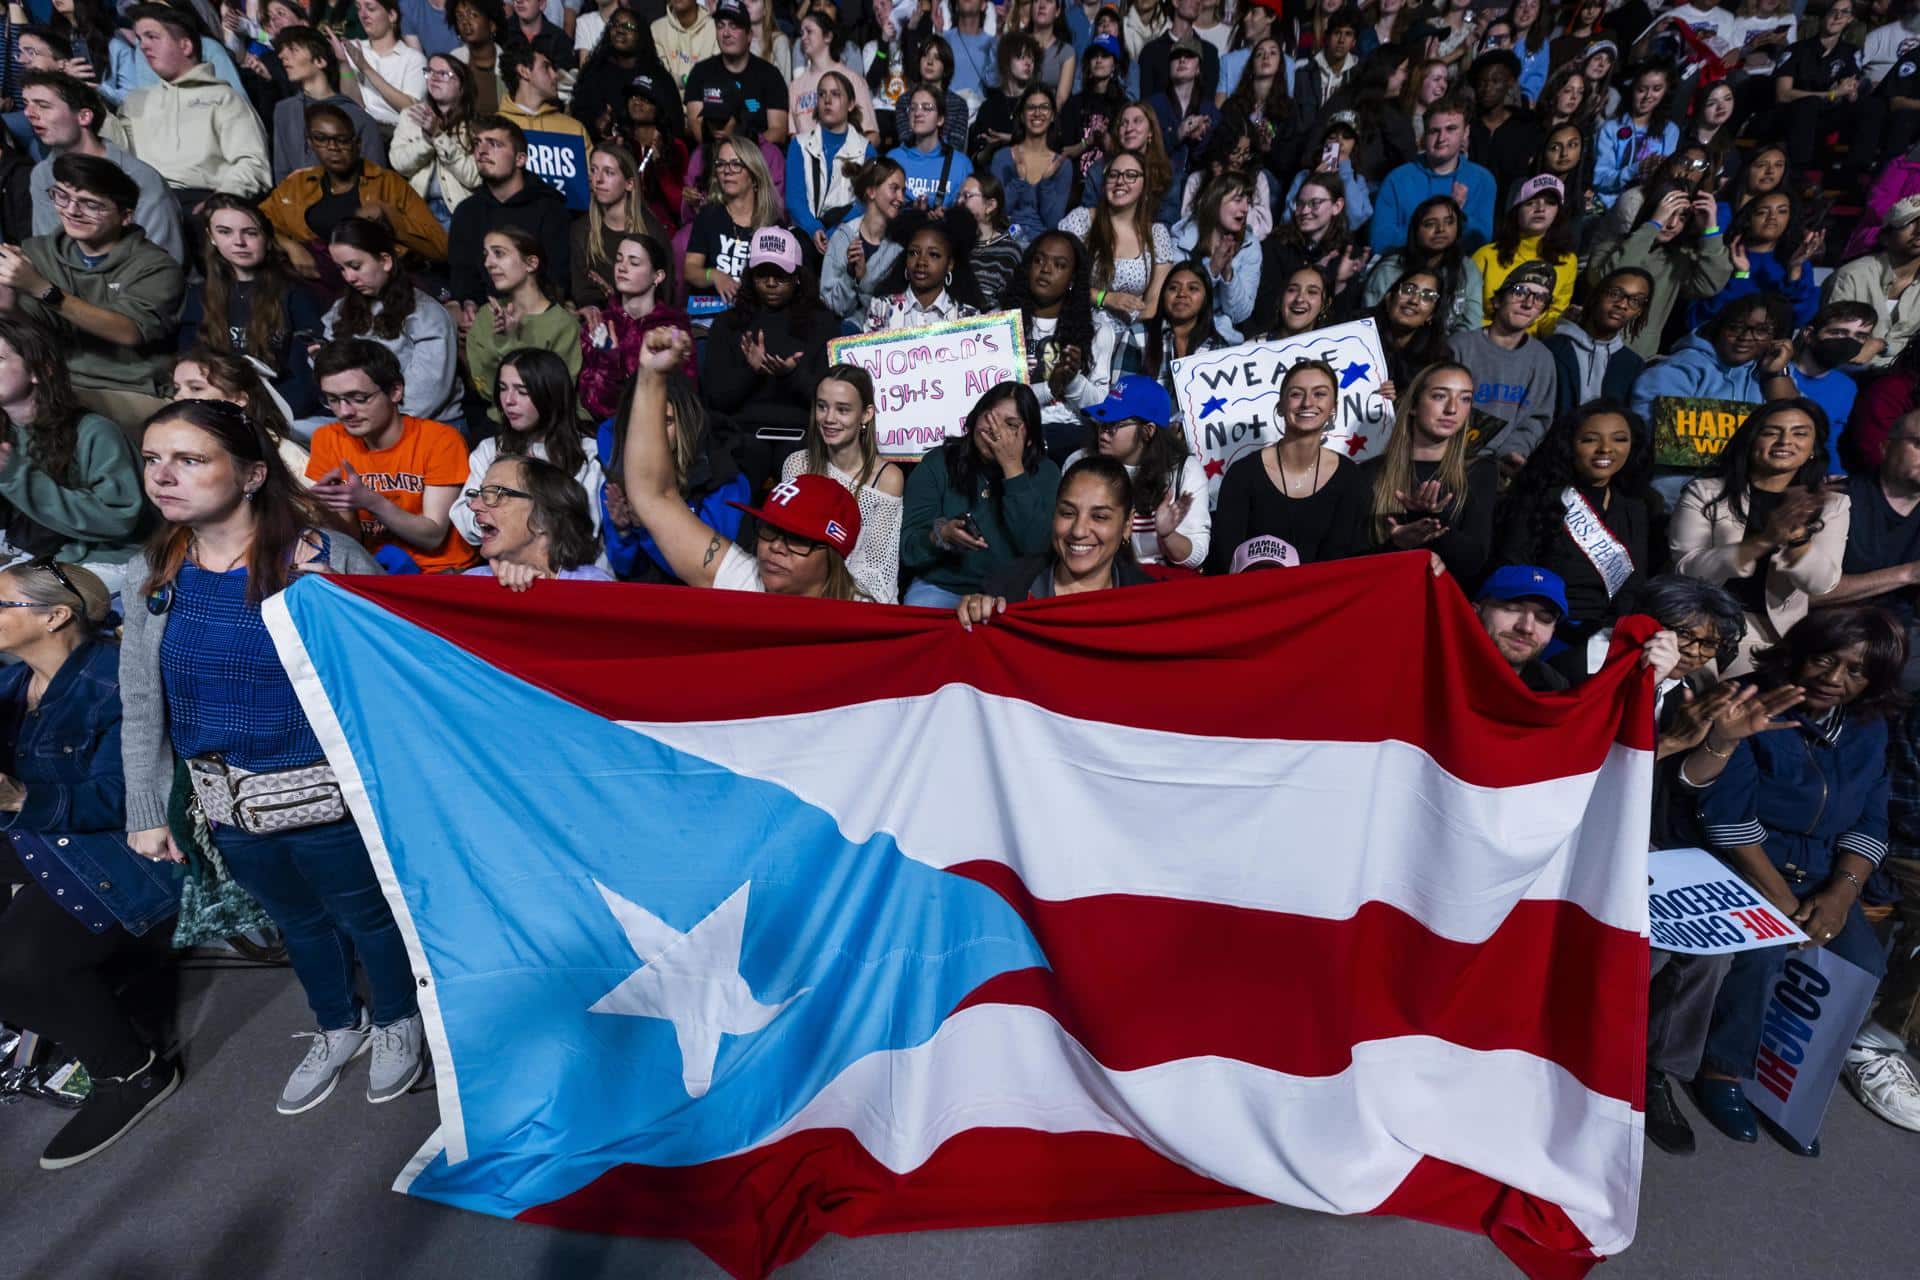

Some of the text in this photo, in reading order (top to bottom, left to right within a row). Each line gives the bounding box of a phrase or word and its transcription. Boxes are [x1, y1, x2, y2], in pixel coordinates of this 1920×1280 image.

[1200, 361, 1262, 390] WE
[873, 379, 944, 413] ights
[1248, 540, 1287, 552] KAMALA
[1248, 547, 1287, 560] HARRIS
[1730, 907, 1796, 940] WE
